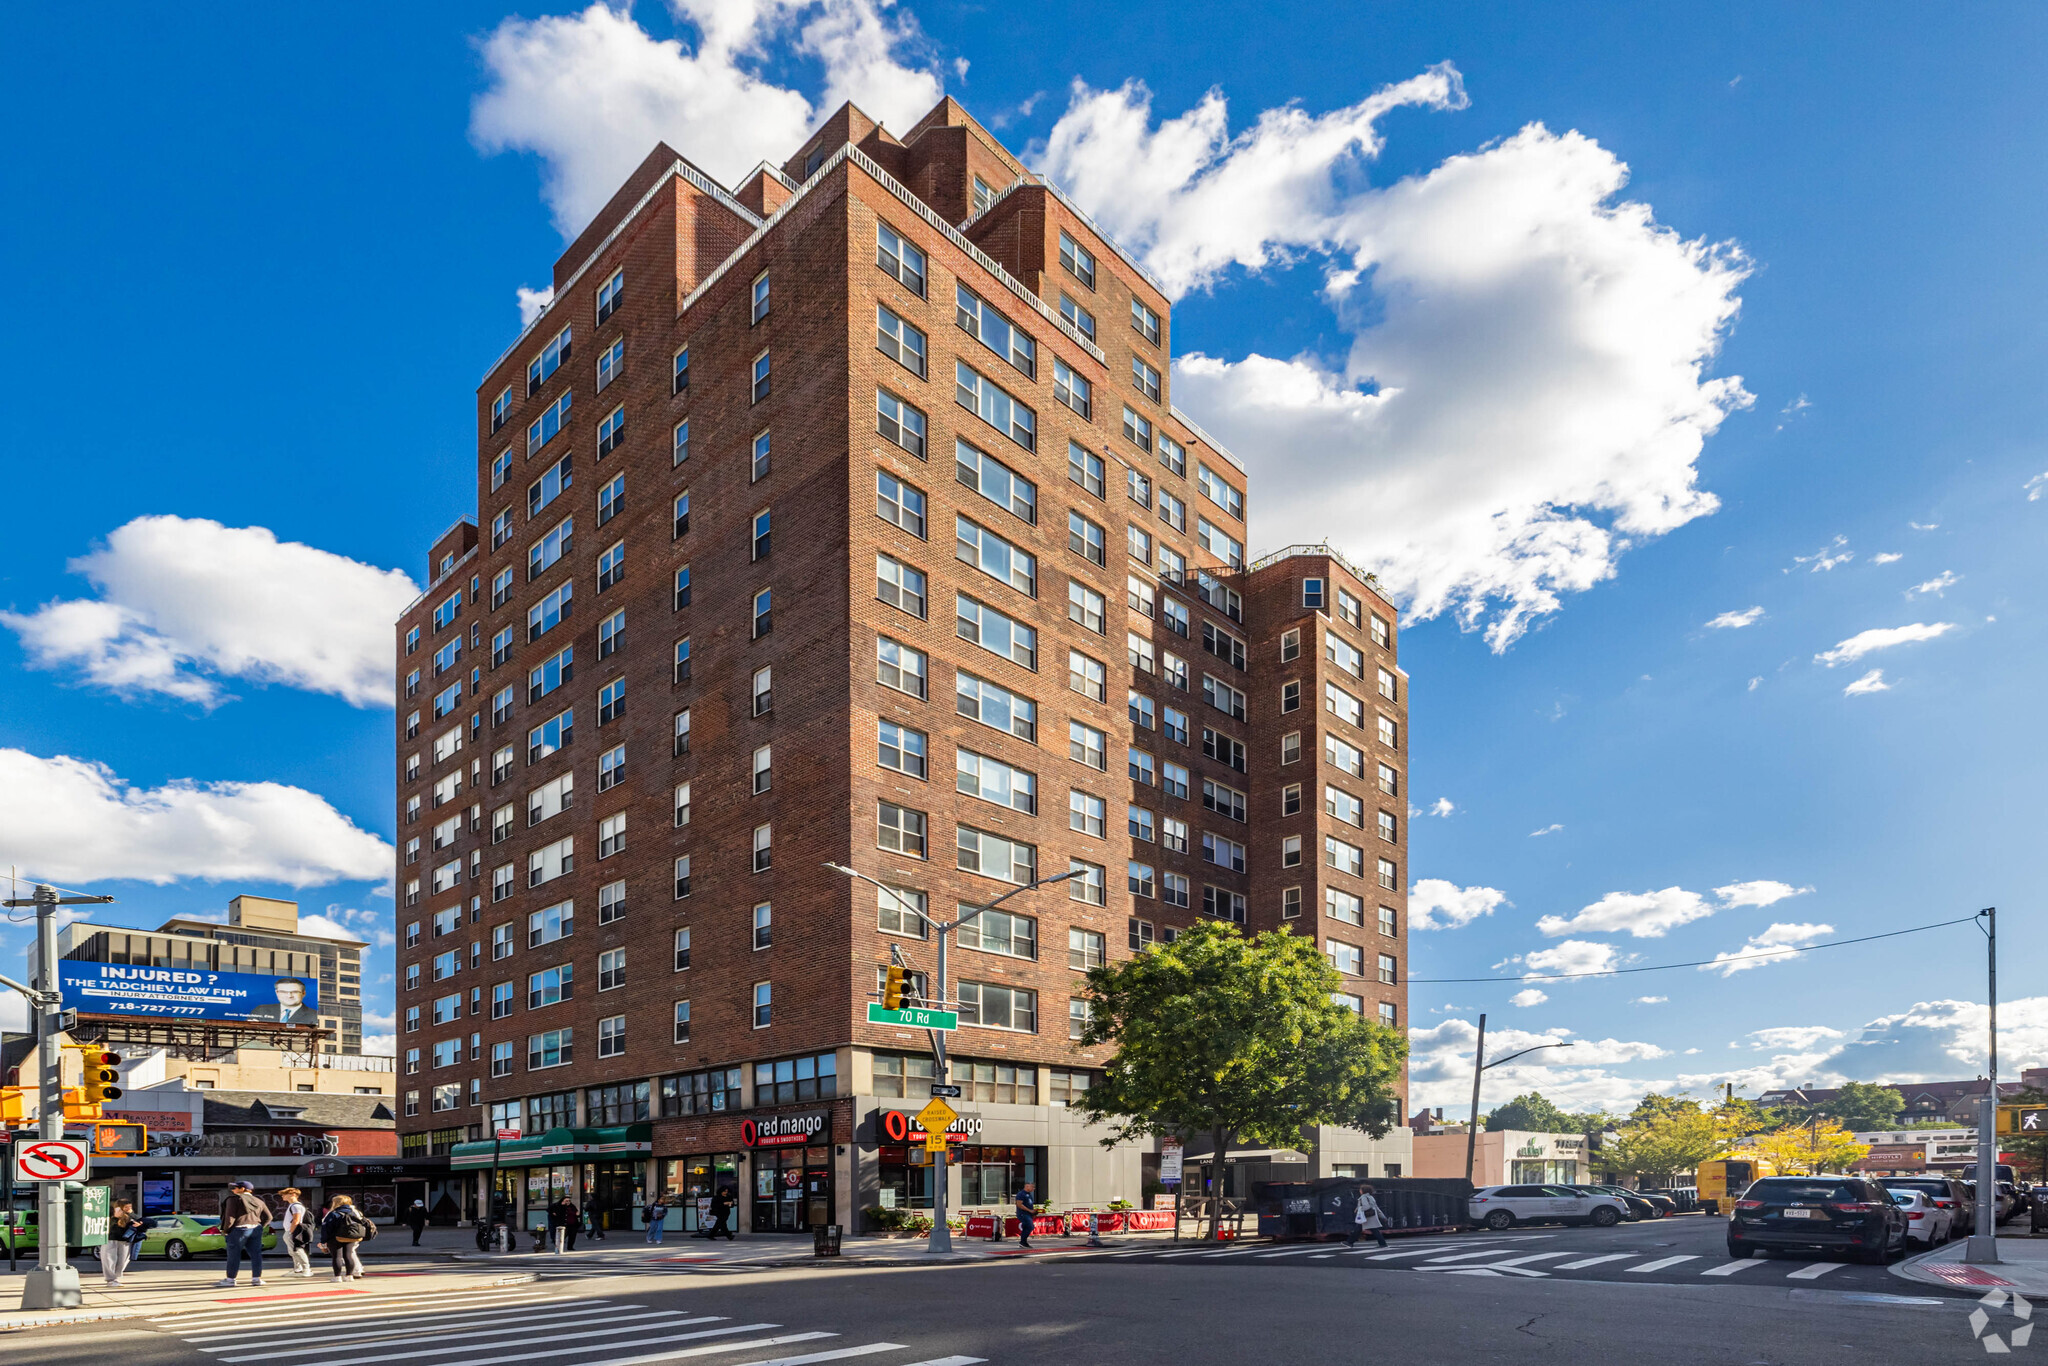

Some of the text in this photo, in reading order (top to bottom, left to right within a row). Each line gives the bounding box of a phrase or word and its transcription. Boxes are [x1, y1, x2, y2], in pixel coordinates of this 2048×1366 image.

[101, 966, 219, 986] INJURED ?
[64, 978, 247, 998] THE TADCHIEV LAW FIRM
[110, 990, 206, 1003] INJURY ATTORNEYS
[109, 1002, 206, 1015] 718-727-7777
[899, 1010, 930, 1025] 70 Rd
[148, 1120, 170, 1128] FOOT
[757, 1116, 822, 1136] red mango
[946, 1118, 983, 1137] ango
[761, 1136, 776, 1144] YOGURT
[930, 1135, 943, 1145] 15
